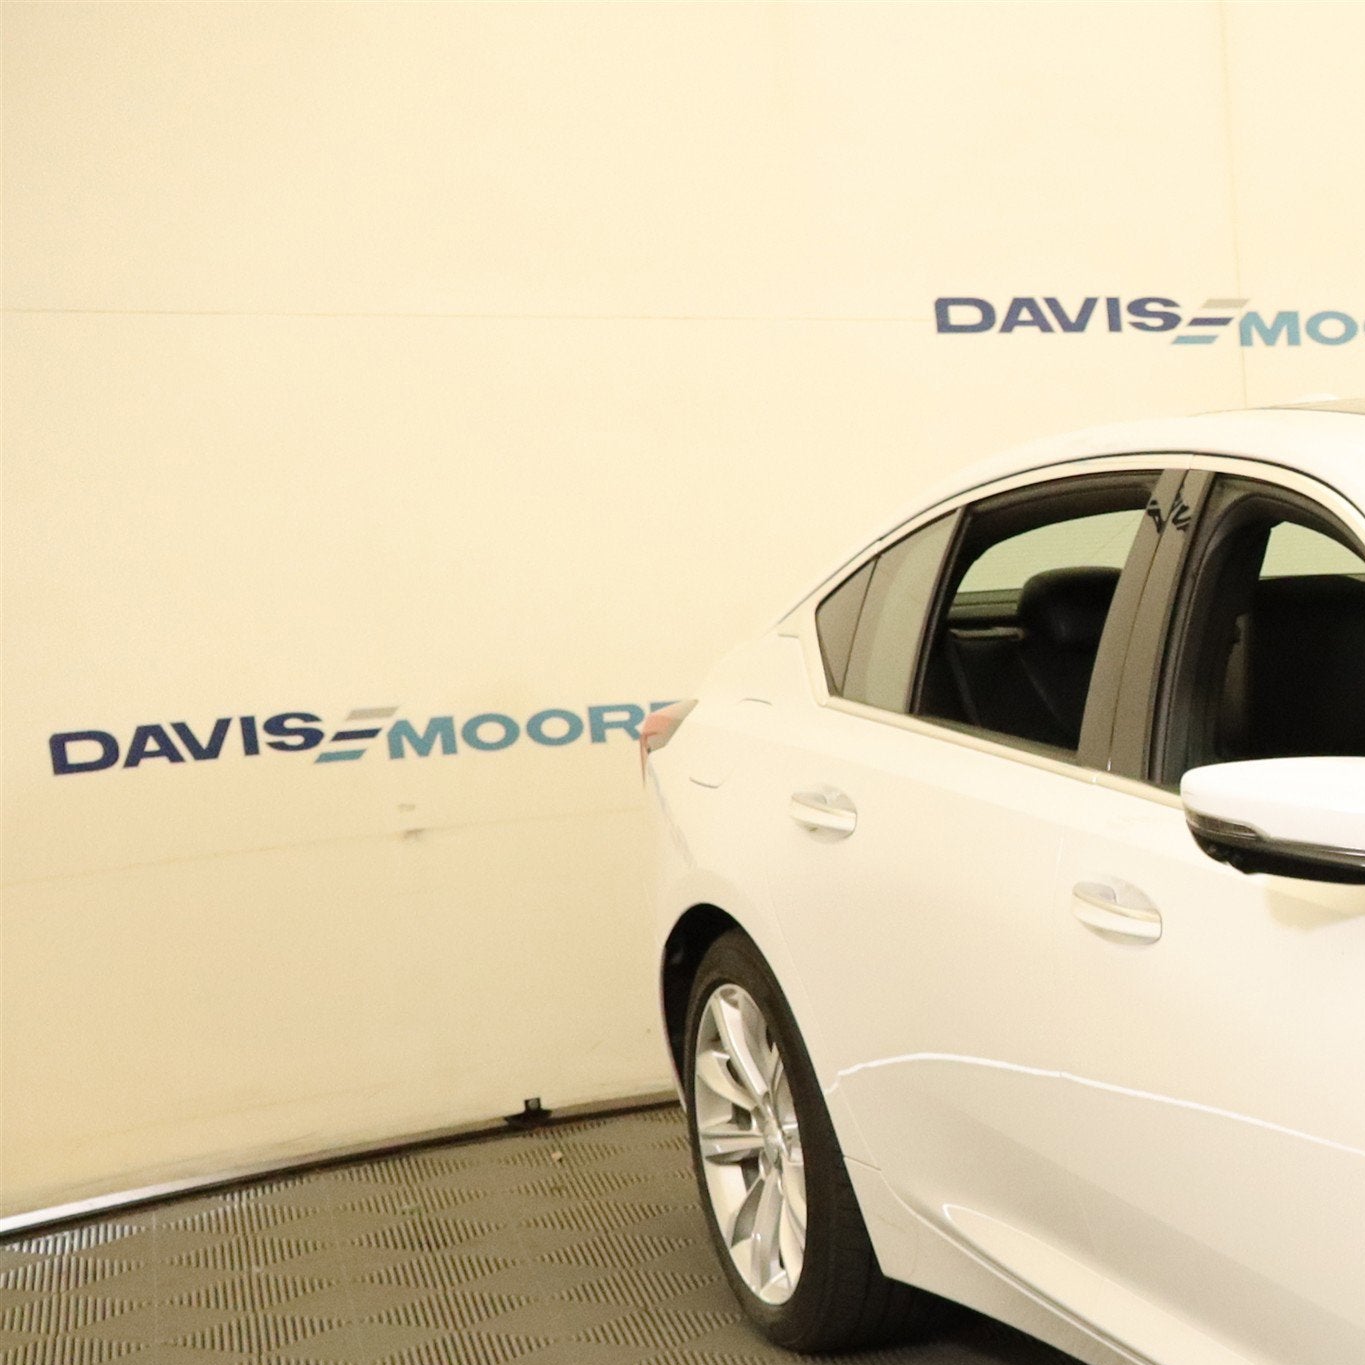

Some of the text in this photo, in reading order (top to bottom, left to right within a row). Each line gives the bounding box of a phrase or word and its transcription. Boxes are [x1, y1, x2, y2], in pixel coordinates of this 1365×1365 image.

[935, 296, 1182, 334] DAVIS
[49, 700, 682, 776] DAVIS MOOR
